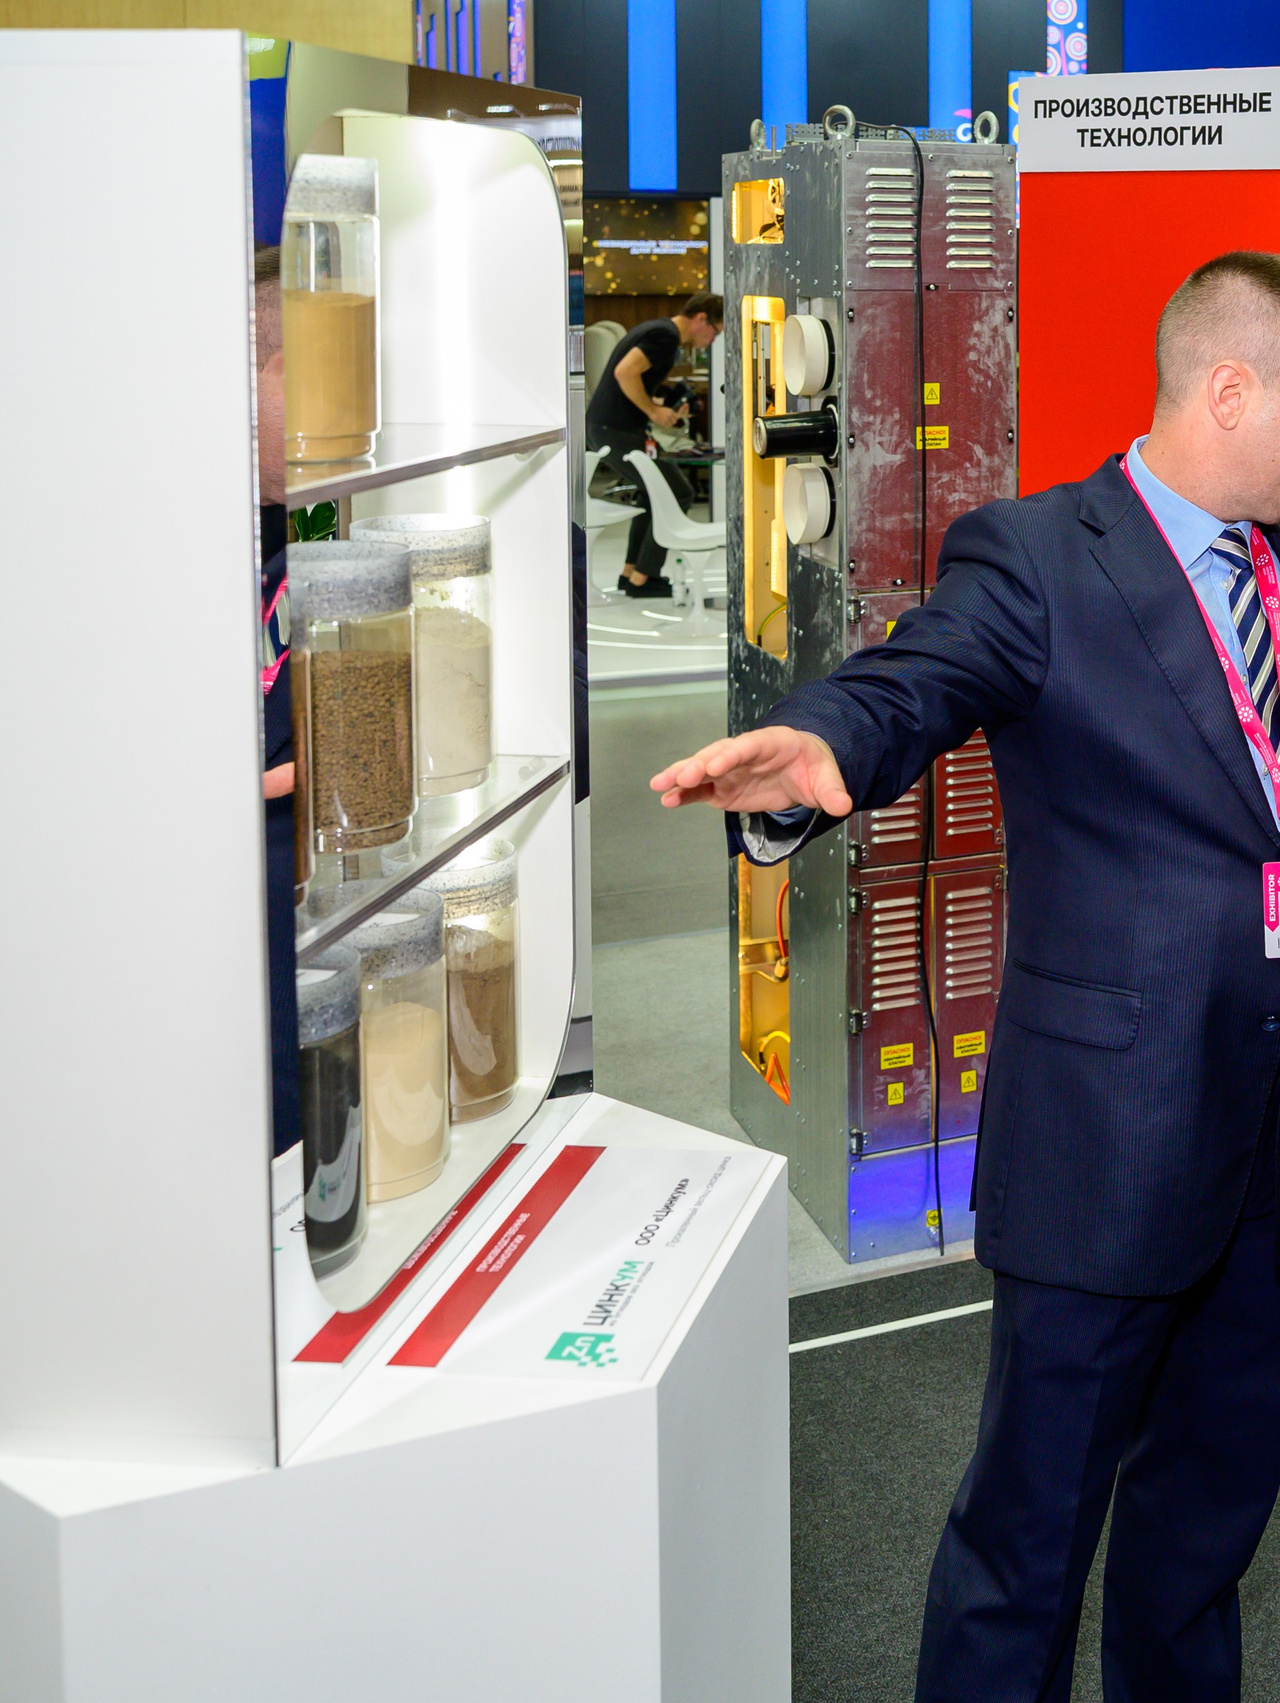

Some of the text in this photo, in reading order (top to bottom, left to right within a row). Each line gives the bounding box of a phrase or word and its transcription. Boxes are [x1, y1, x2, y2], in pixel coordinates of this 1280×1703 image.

[1034, 92, 1272, 119] ПРОИЗВОДСТВЕННЫЕ
[1077, 125, 1223, 148] ТЕХНОЛОГИИ
[1268, 874, 1276, 922] EXHIBITOR
[635, 1224, 660, 1246] ООО
[583, 1260, 645, 1326] ЦИНКУМ
